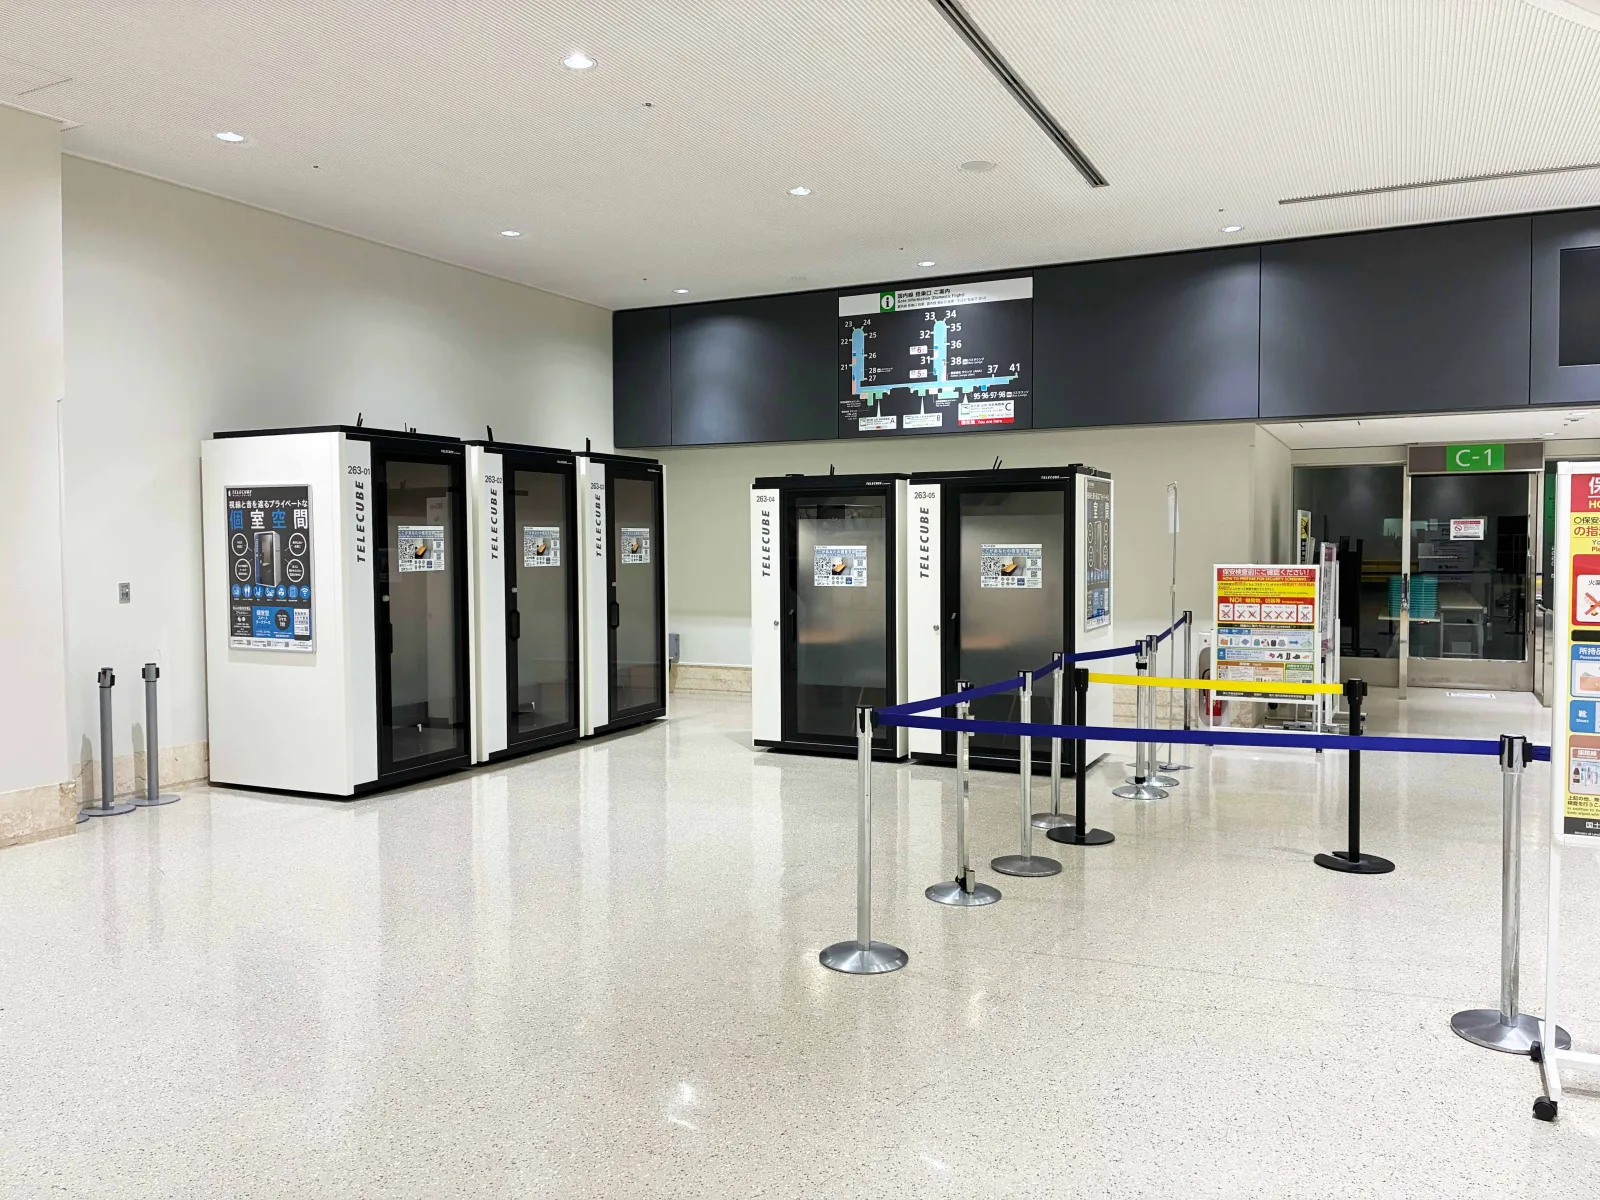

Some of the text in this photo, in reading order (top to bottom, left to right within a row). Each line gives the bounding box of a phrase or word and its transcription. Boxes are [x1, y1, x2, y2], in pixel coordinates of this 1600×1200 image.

[924, 311, 935, 320] 33
[945, 310, 956, 318] 34
[950, 323, 961, 332] 35
[919, 330, 930, 339] 32
[950, 340, 961, 348] 36
[920, 356, 930, 365] 31
[950, 357, 961, 365] 38
[987, 364, 998, 373] 37
[1009, 363, 1020, 371] 41
[1005, 402, 1011, 411] C
[1456, 448, 1491, 467] C-1
[348, 465, 370, 475] 263-01
[914, 491, 935, 499] 263-05
[355, 480, 365, 563] TELECUBE
[490, 488, 498, 560] TELECUBE
[761, 510, 770, 577] TELECUBE
[920, 507, 929, 578] TELECUBE
